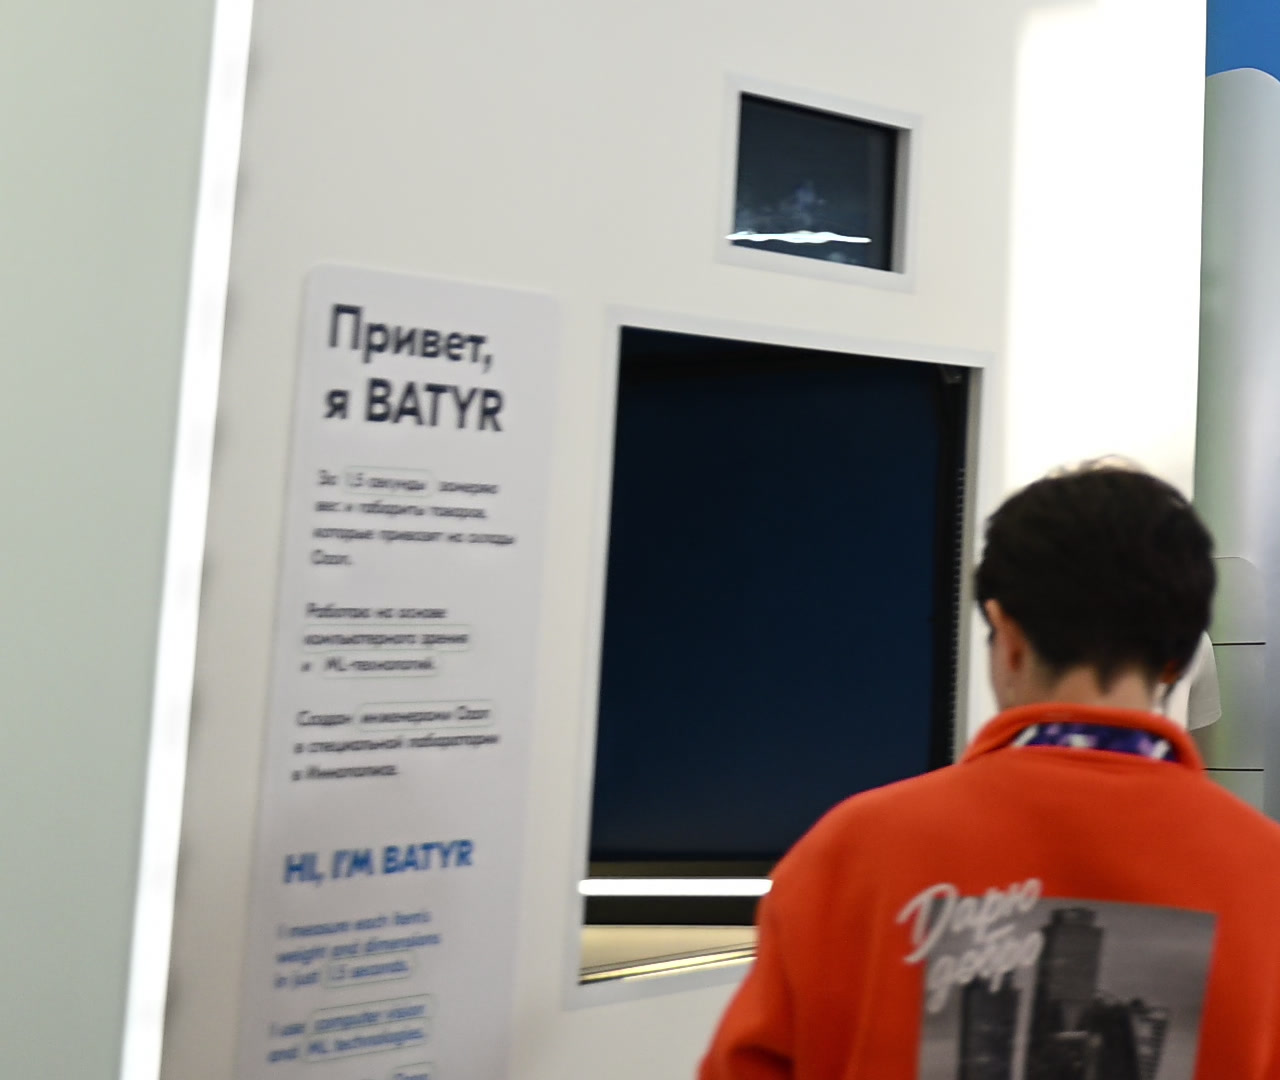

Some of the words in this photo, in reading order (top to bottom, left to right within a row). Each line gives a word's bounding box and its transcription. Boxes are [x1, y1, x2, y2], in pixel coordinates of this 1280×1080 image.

[328, 304, 493, 373] Привет,
[324, 389, 350, 419] я
[364, 378, 504, 432] BATYR
[382, 838, 475, 875] BATYR
